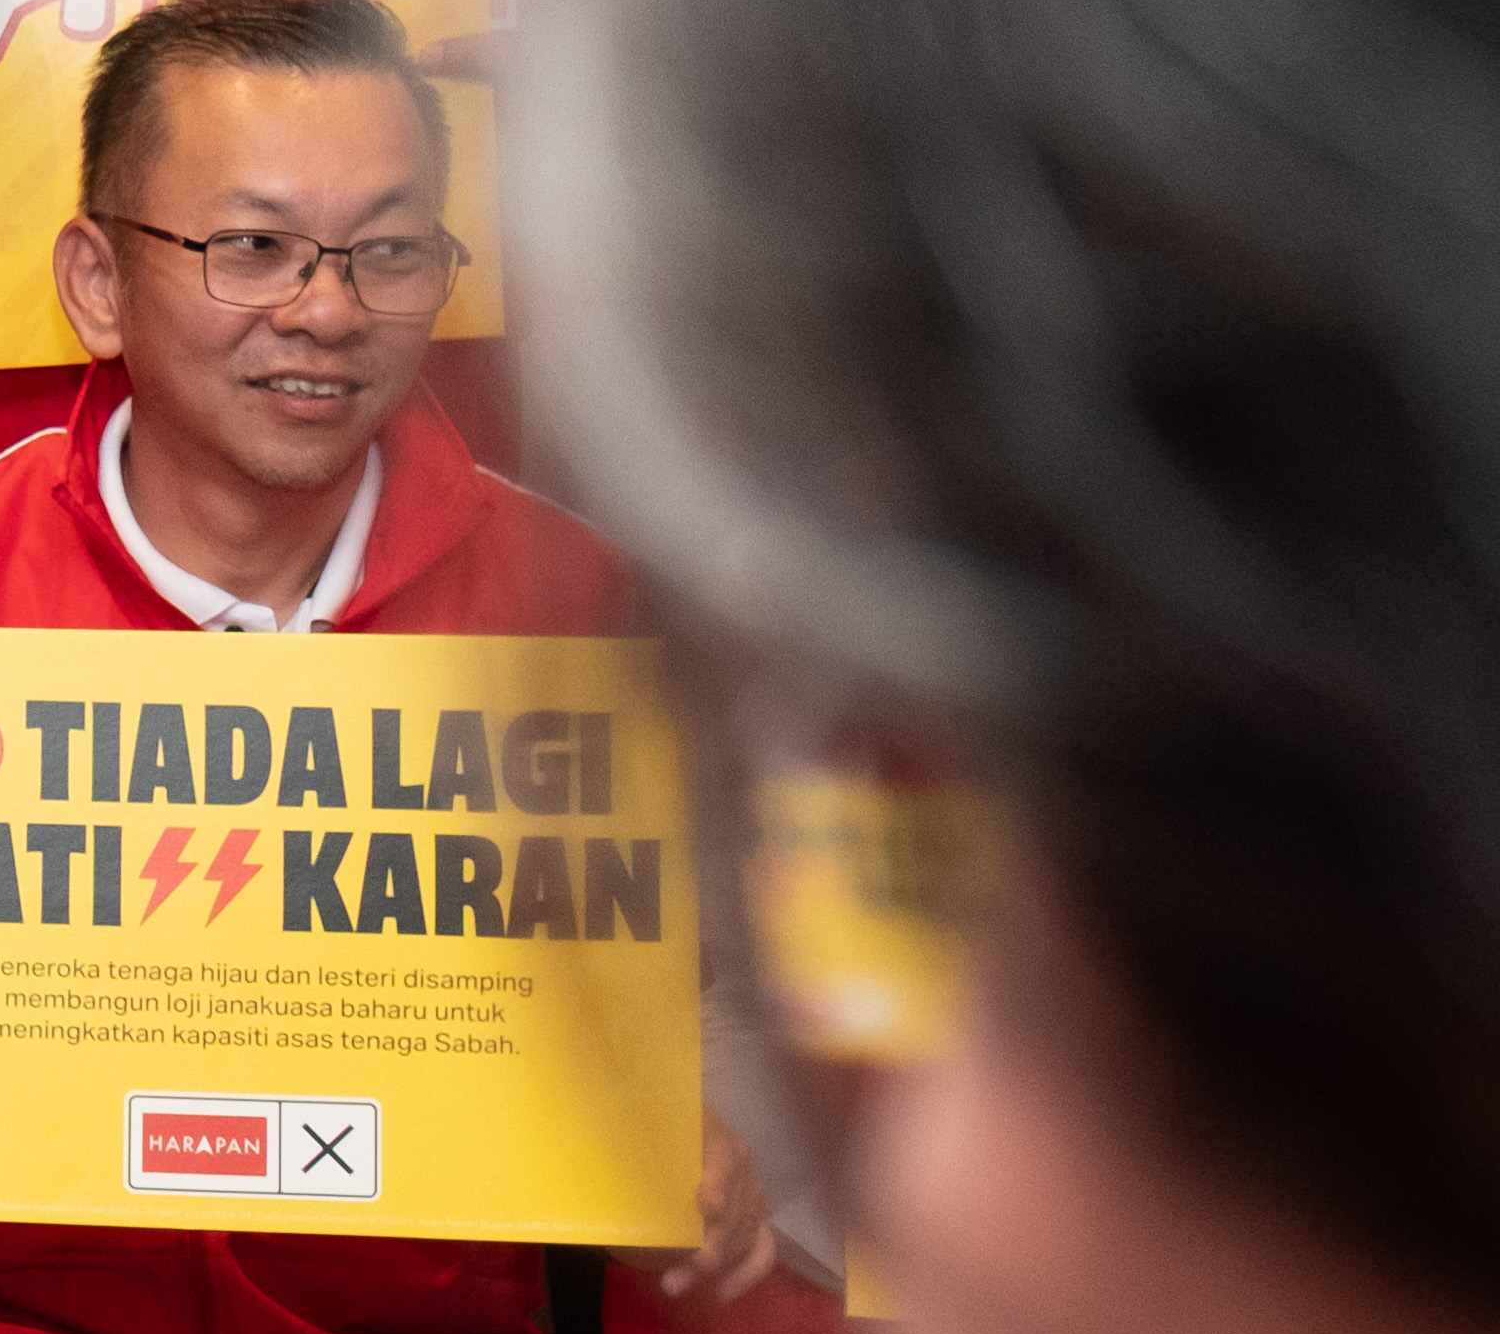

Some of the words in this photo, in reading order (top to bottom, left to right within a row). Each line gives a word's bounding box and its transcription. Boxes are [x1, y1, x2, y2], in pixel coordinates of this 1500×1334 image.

[25, 699, 347, 808] TIADA
[371, 709, 613, 816] LAGI
[281, 831, 663, 943] KARAN
[108, 960, 193, 986] tenaga
[201, 963, 257, 987] hijau
[264, 965, 311, 985] dan
[318, 967, 396, 988] lesteri
[403, 969, 534, 997] disamping
[5, 989, 159, 1016] membangun
[167, 993, 201, 1018] loji
[206, 994, 332, 1019] janakuasa
[341, 999, 426, 1021] baharu
[434, 1002, 506, 1023] untuk
[173, 1025, 269, 1051] kapasiti
[276, 1030, 333, 1049] asas
[340, 1031, 427, 1056] tenaga
[434, 1033, 521, 1057] Sabah.
[148, 1134, 261, 1158] HARAPAN
